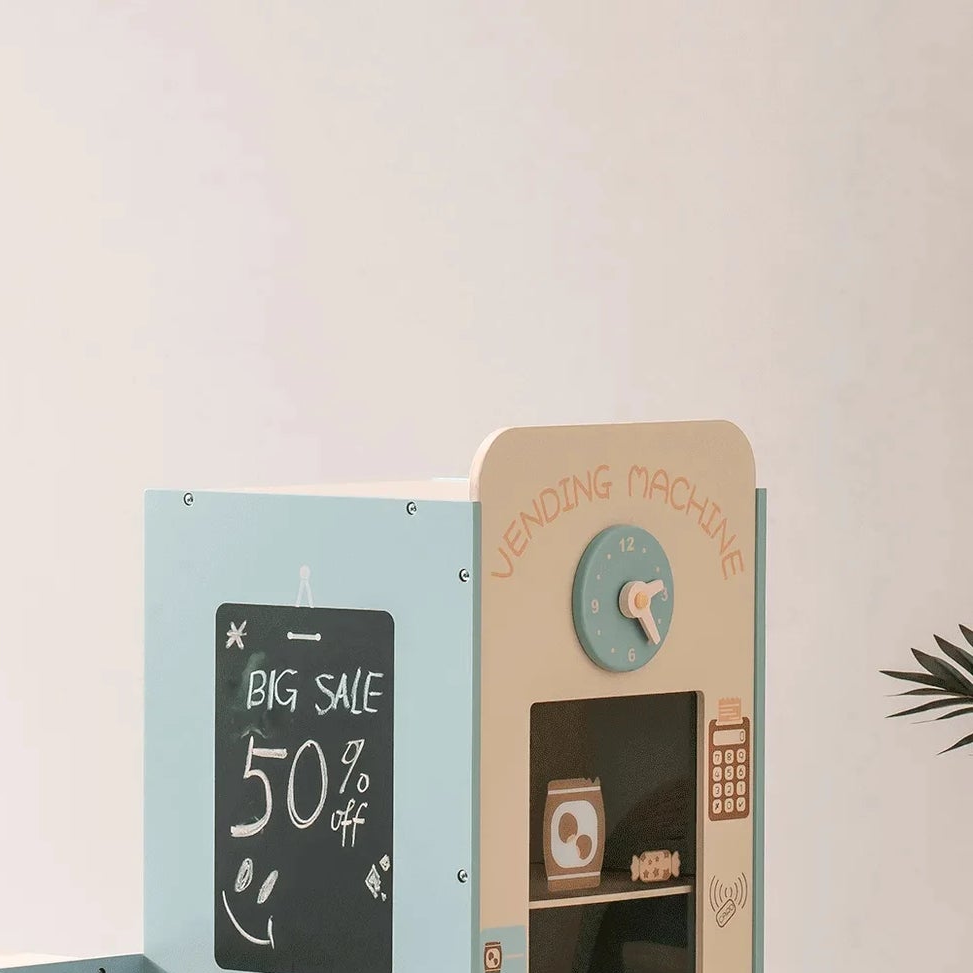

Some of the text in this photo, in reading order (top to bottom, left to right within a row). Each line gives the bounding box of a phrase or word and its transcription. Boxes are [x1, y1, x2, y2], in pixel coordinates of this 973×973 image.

[491, 464, 745, 580] VENDING MACHINE
[619, 537, 635, 552] 12
[591, 600, 599, 613] 9
[627, 649, 636, 662] 6
[247, 667, 384, 715] BIG SALE
[331, 799, 368, 847] off
